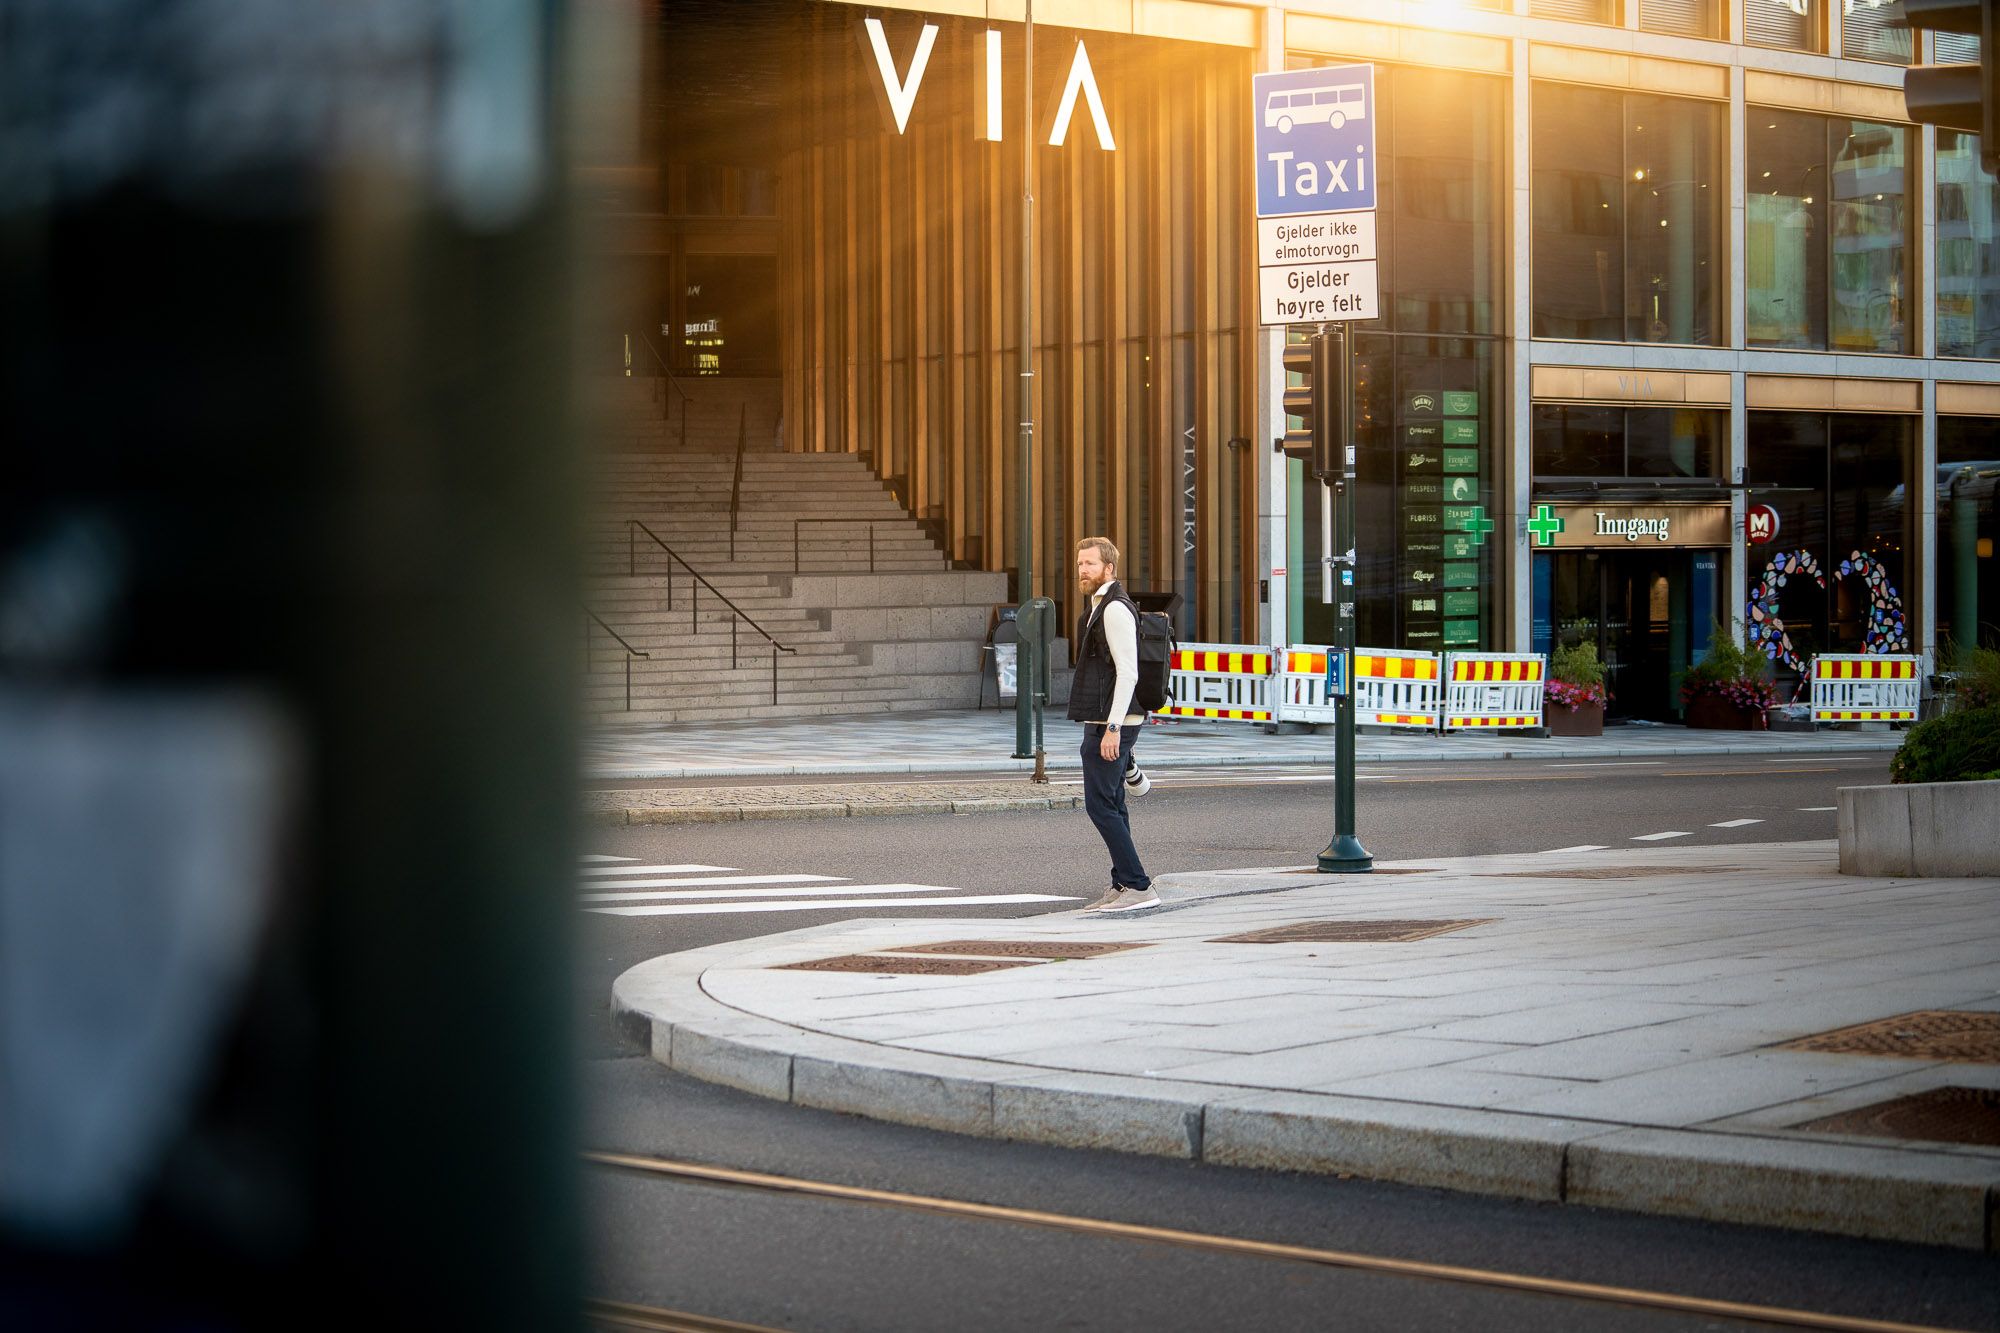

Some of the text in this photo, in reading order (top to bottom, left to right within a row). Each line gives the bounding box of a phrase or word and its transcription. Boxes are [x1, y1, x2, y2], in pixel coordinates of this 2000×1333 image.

[862, 17, 1117, 151] VIA
[1267, 144, 1365, 197] Taxi
[1276, 221, 1358, 242] Gjelder ikke
[1275, 243, 1360, 259] elmotorvogn
[1287, 269, 1350, 294] Gjelder
[1276, 293, 1362, 318] høyre felt
[1618, 375, 1653, 396] VIA
[1595, 512, 1670, 541] Inngang
[1750, 513, 1769, 532] M
